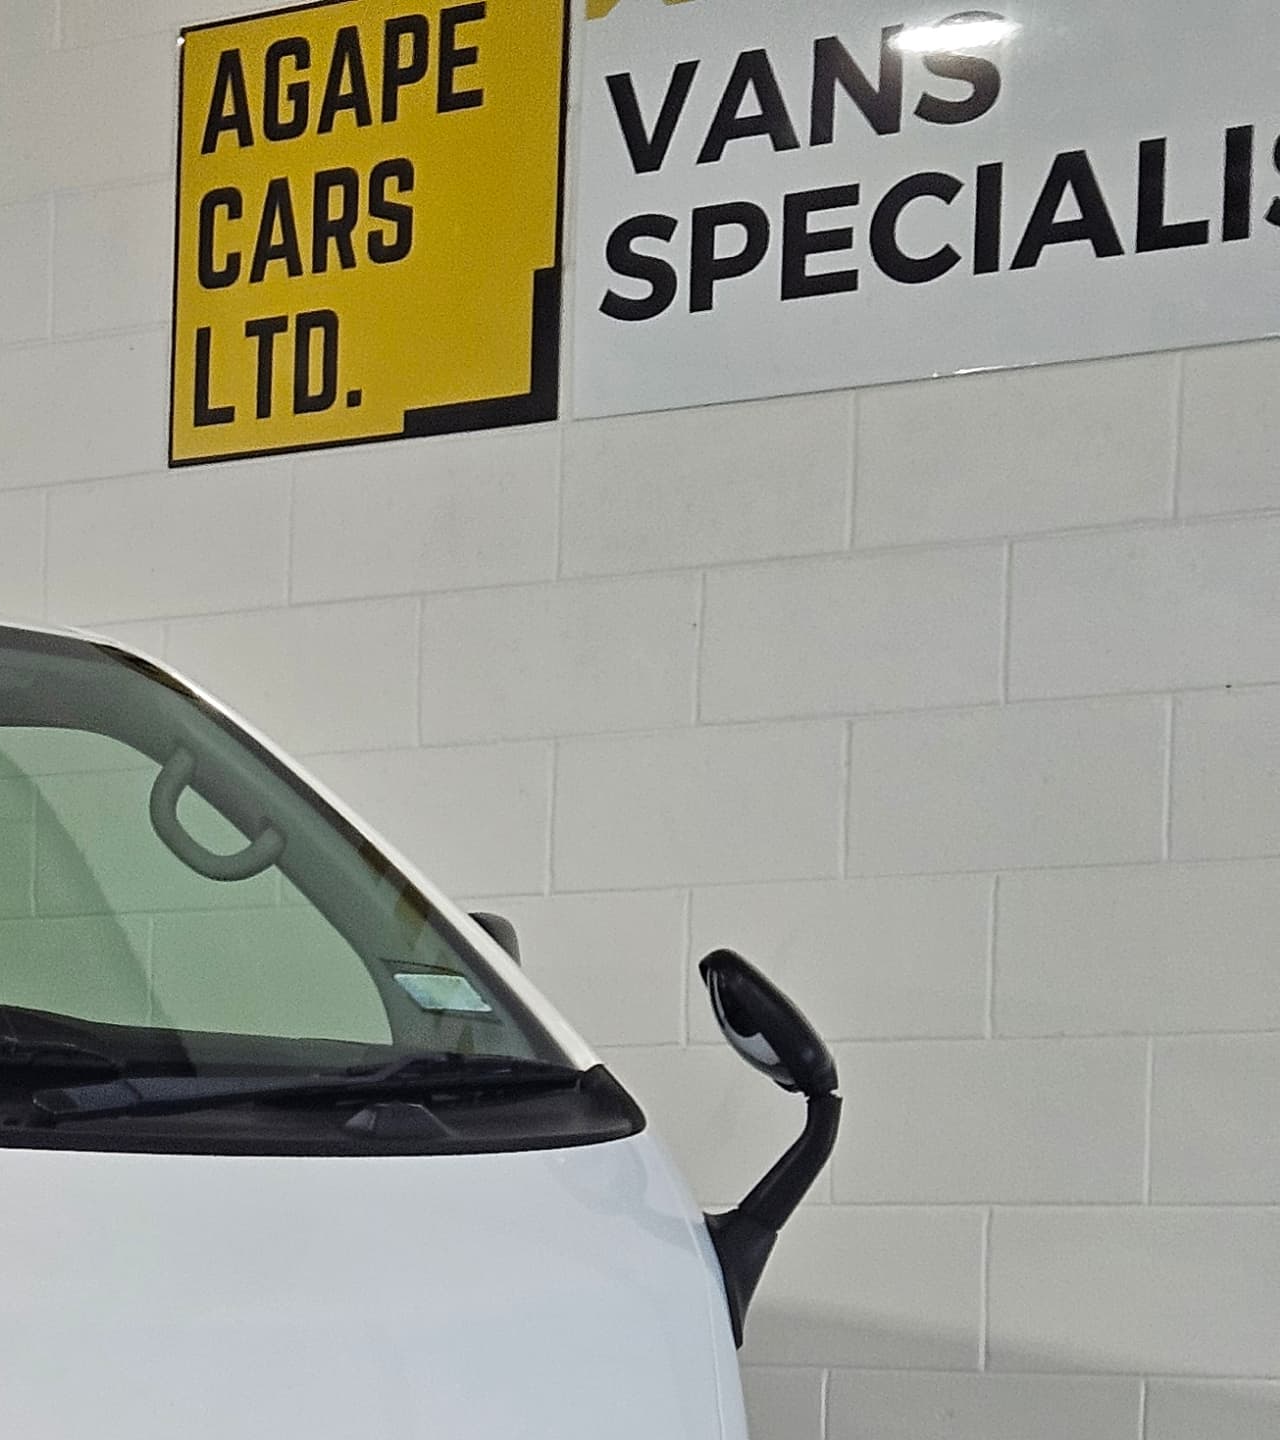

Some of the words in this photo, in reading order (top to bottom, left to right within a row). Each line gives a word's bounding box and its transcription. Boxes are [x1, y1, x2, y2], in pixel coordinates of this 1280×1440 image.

[200, 0, 487, 155] AGAPE
[605, 10, 1001, 175] VANS
[197, 157, 415, 290] CARS
[598, 122, 1280, 322] SPECIALI
[193, 309, 362, 428] LTD.
